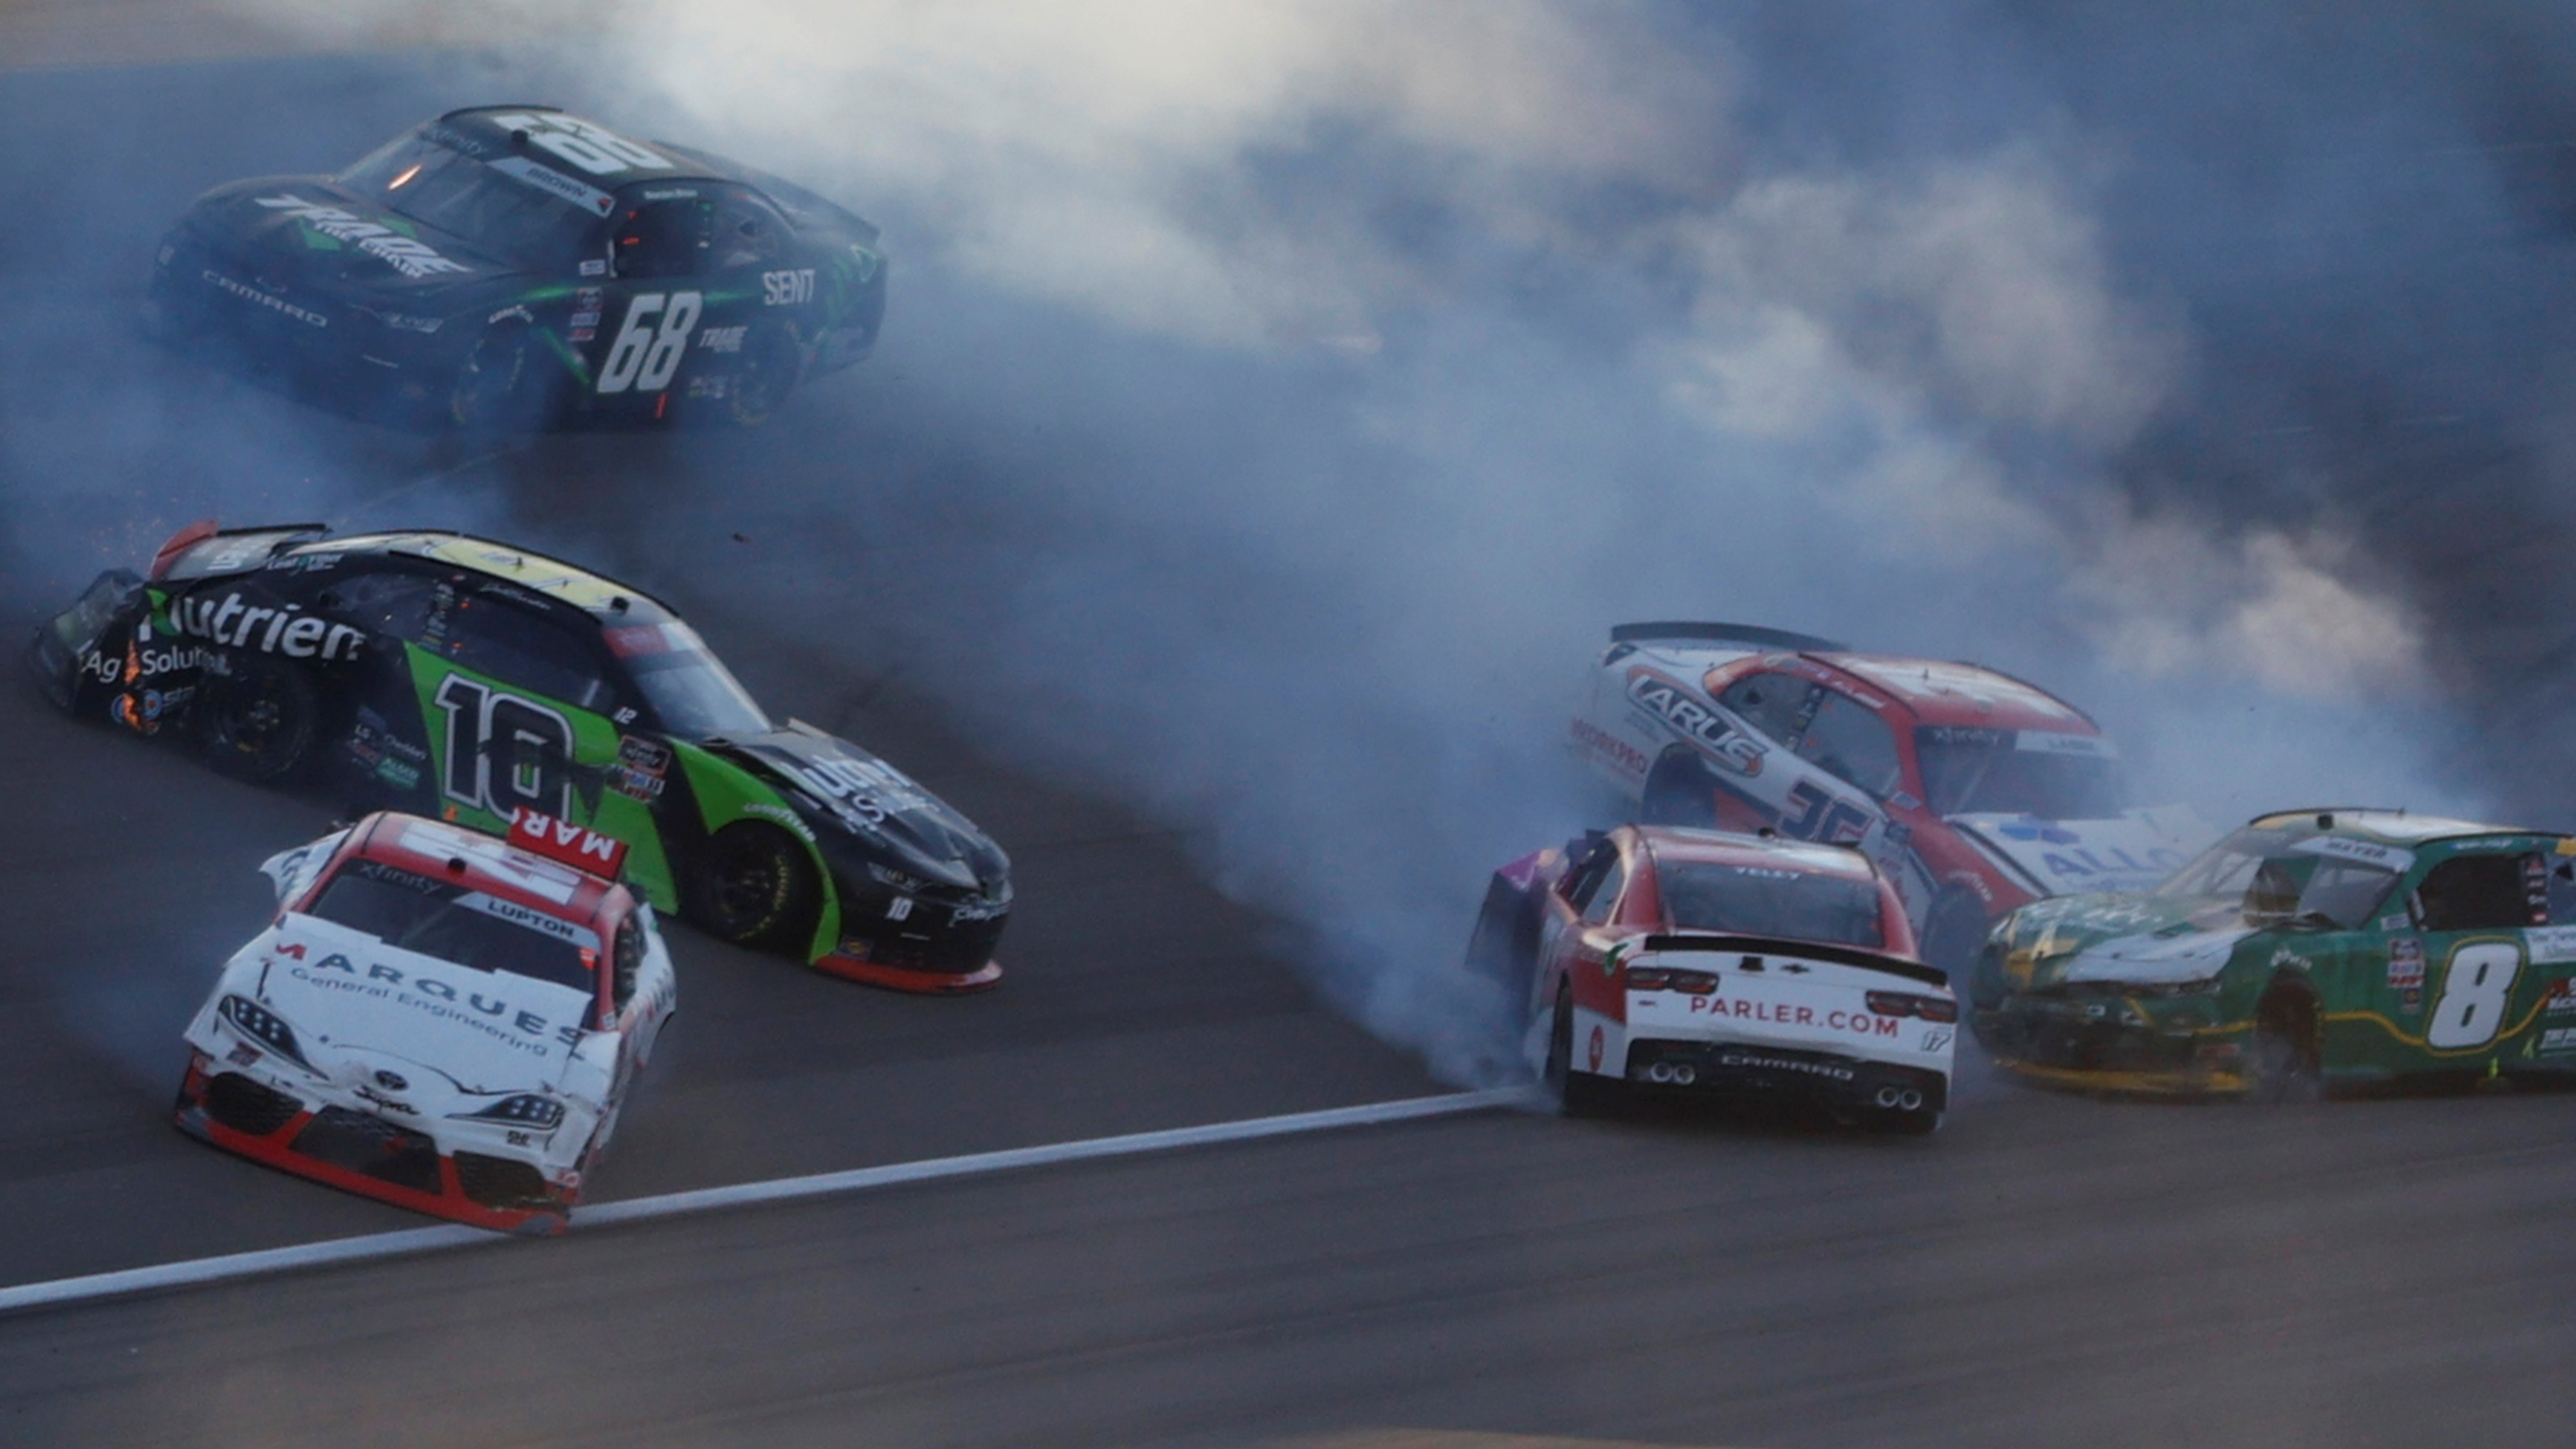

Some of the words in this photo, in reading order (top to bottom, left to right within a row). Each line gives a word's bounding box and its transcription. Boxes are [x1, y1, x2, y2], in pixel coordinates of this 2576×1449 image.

[524, 167, 587, 198] BROWN
[202, 269, 328, 327] CAMARO
[762, 268, 816, 305] SENT
[596, 291, 702, 394] 68
[83, 649, 121, 684] Ag
[359, 862, 443, 895] xfinity
[487, 894, 576, 938] LUPTON
[885, 896, 913, 921] 10
[290, 966, 389, 1000] General
[395, 990, 550, 1057] Engineering
[2427, 942, 2520, 1049] 8
[1689, 995, 1899, 1038] PARLER.COM
[1721, 1054, 1855, 1081] CAMARO
